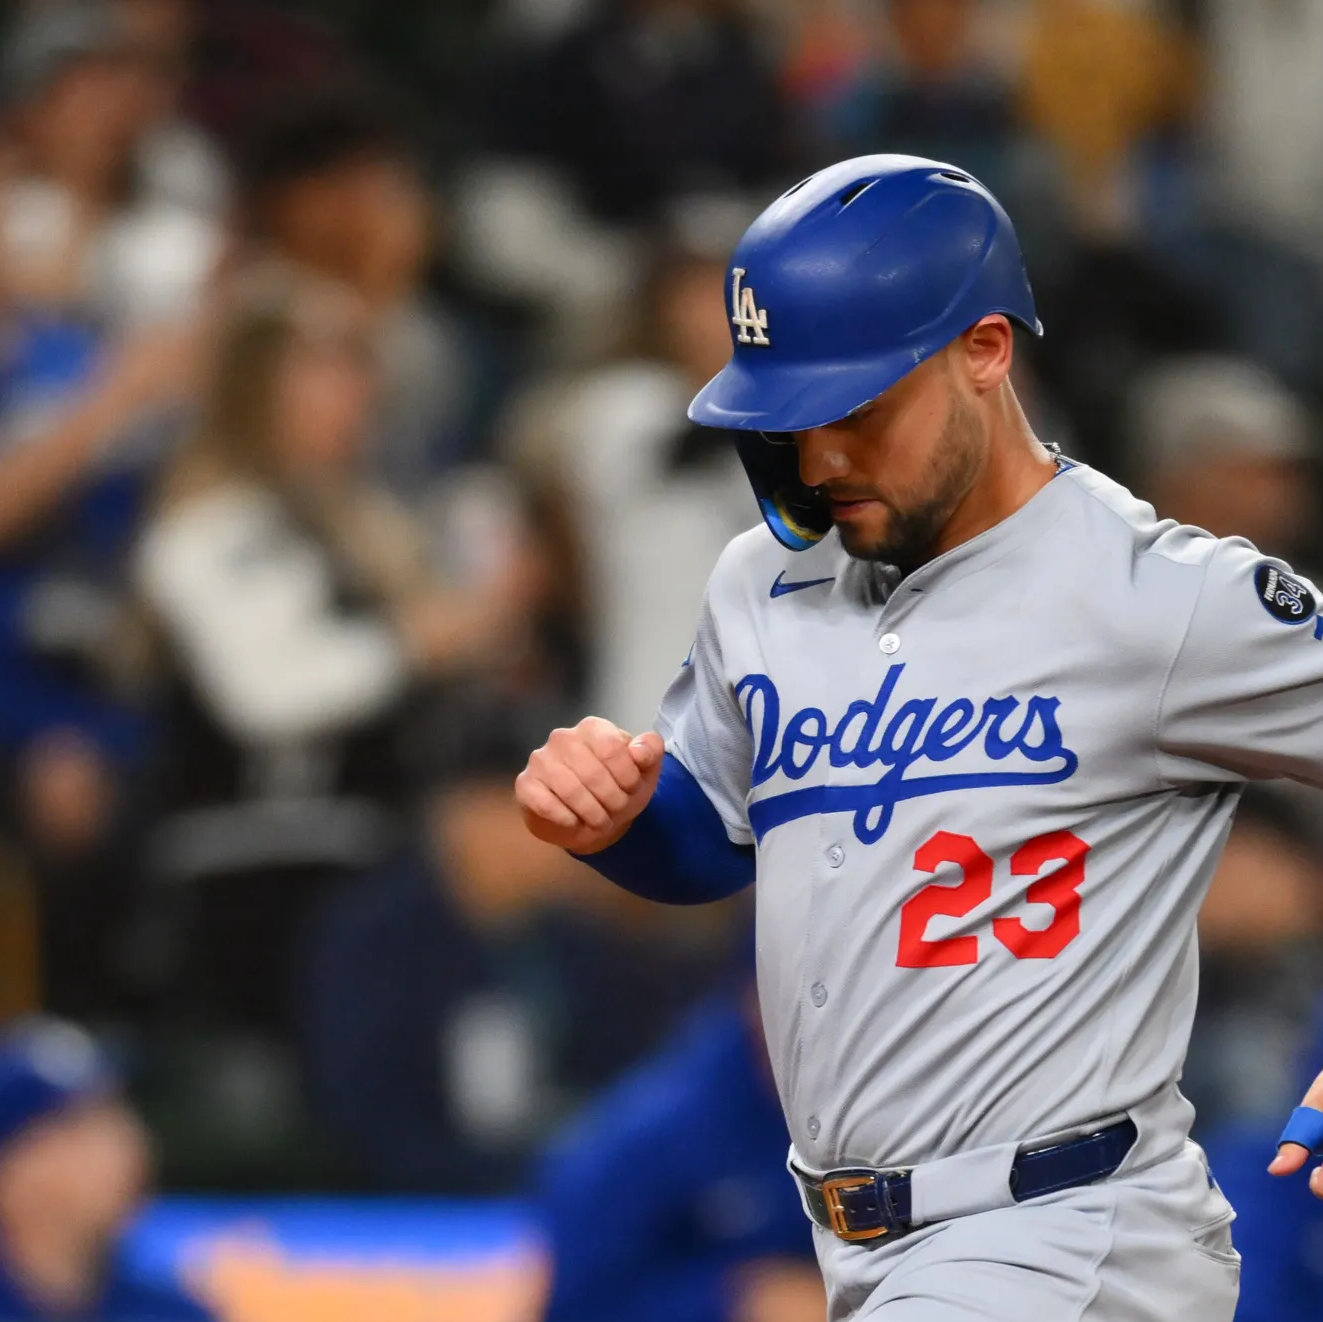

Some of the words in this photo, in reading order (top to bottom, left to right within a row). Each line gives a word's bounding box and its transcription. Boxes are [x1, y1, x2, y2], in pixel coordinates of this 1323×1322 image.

[732, 267, 769, 345] LA
[1275, 576, 1307, 614] 34
[734, 663, 1078, 846] Dodgers
[895, 830, 1092, 968] 23
